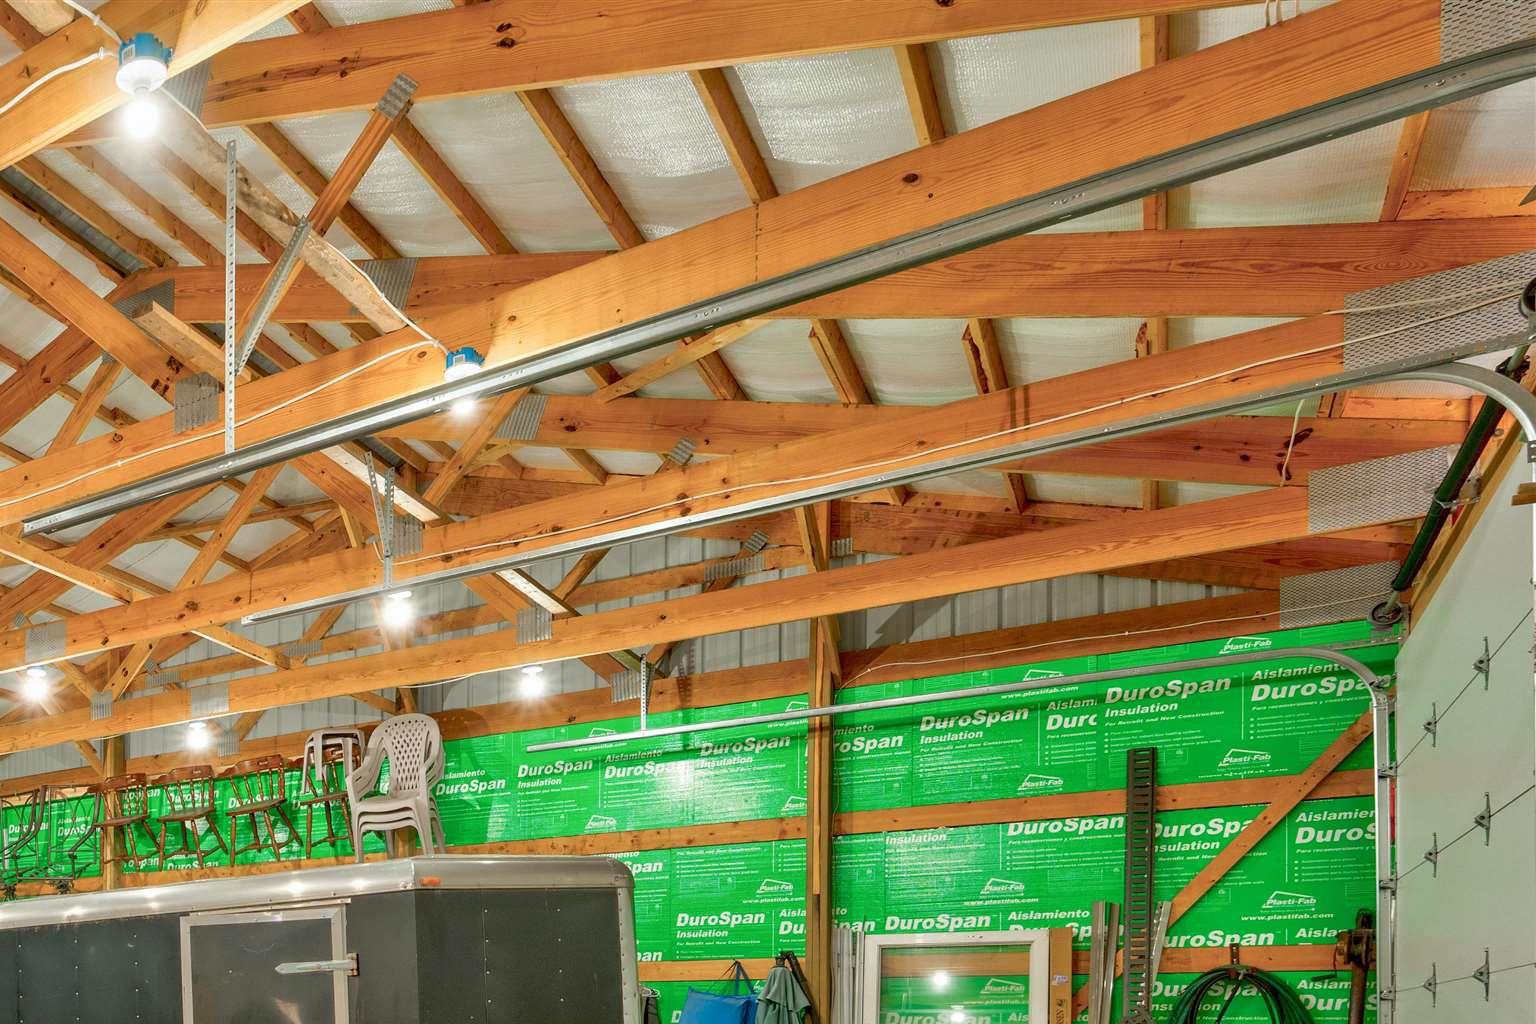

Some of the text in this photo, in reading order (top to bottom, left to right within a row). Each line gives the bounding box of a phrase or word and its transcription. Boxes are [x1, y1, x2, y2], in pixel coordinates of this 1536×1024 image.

[1224, 638, 1272, 651] Plasti-Fab
[1001, 685, 1079, 699] www.plastifab.com
[1104, 677, 1231, 704] DuroSpan
[1104, 702, 1178, 718] Insulation
[920, 707, 1029, 731] DuroSpan
[834, 724, 874, 736] miento
[920, 730, 983, 745] Insulation
[700, 734, 791, 756] DuroSpan
[834, 736, 903, 753] roSpan
[605, 748, 663, 763] Aislamiento
[700, 756, 753, 768] Insulation
[1223, 753, 1272, 764] Plasti-Fab
[517, 760, 593, 778] DuroSpan
[436, 778, 506, 795] DuroSpan
[518, 777, 562, 789] Insulation
[1022, 779, 1064, 788] Plasti-Fab
[1007, 815, 1124, 836] DuroSpan
[885, 833, 947, 845] Insulation
[1153, 840, 1220, 853] nsulation
[985, 883, 1025, 892] Plasti-Fab
[964, 897, 1039, 906] www.plastifab.com
[1267, 897, 1316, 907] Plasti-Fab
[676, 911, 765, 928] DuroSpan
[1008, 910, 1090, 921] Aislamiento
[1241, 912, 1333, 922] www.plastifab.com
[885, 914, 991, 932] DuroSpan
[676, 929, 728, 939] Insulation
[1165, 930, 1274, 947] uroSpan
[984, 984, 1025, 993] Plasti-Fab
